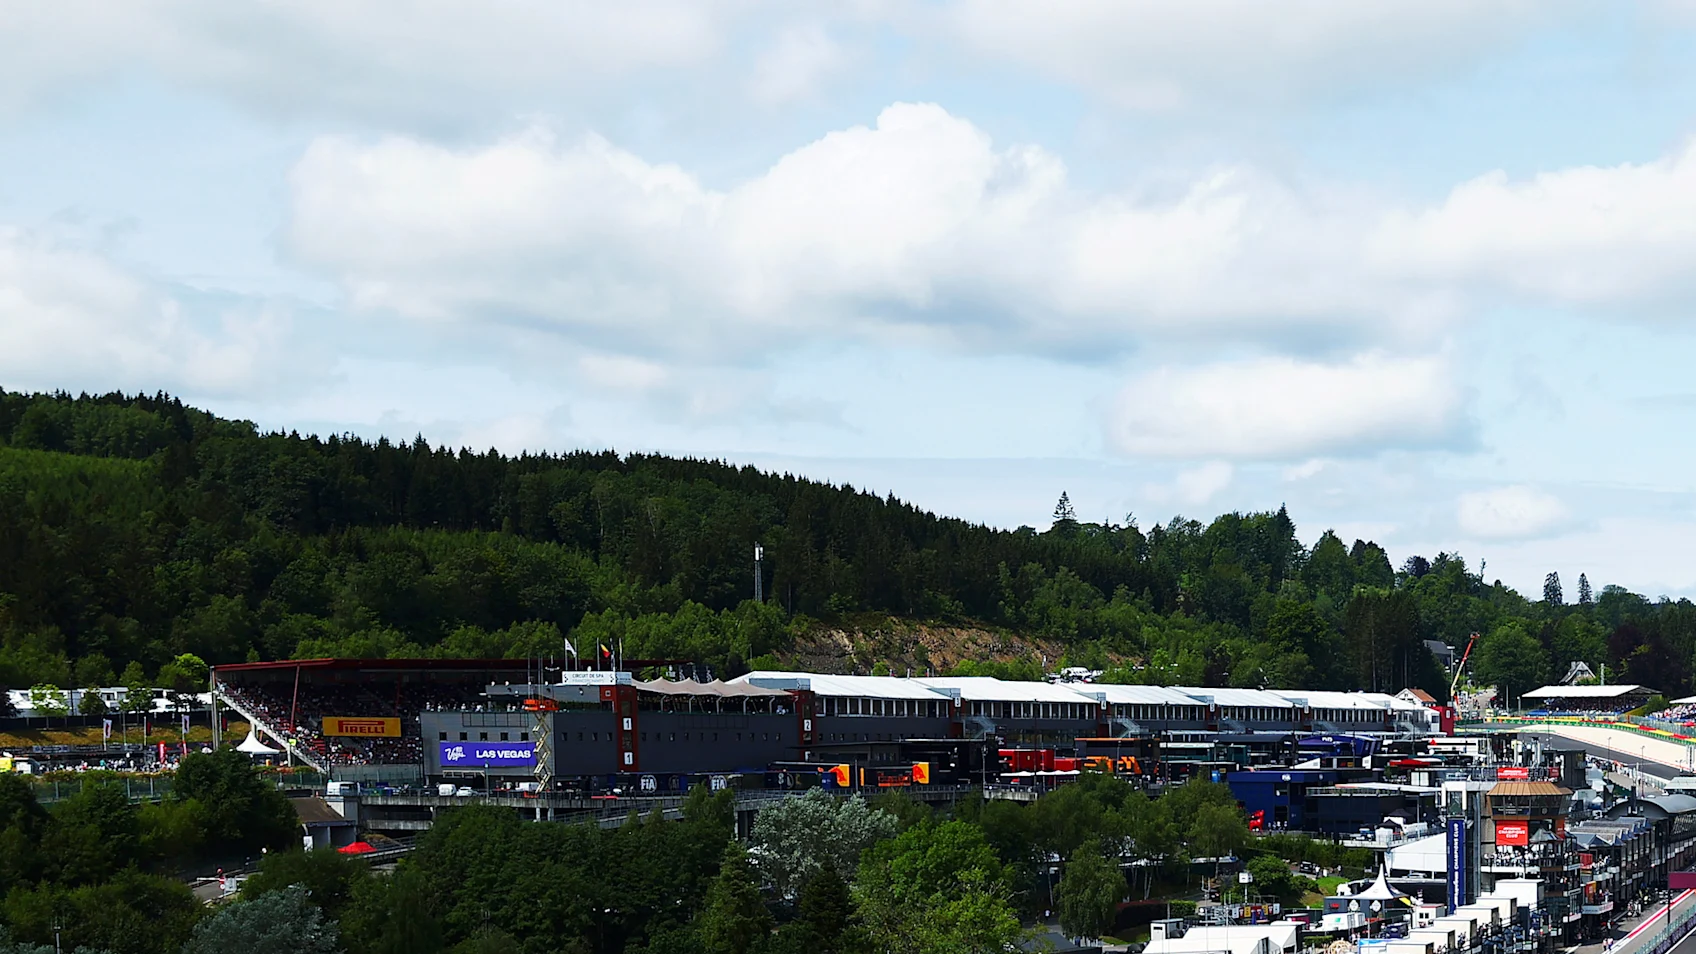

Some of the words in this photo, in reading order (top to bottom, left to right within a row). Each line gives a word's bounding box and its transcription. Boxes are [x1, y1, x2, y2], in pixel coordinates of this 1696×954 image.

[338, 720, 385, 734] PIRELLI
[476, 750, 496, 758] LAS
[498, 750, 531, 759] VEGAS
[640, 777, 655, 790] FIA
